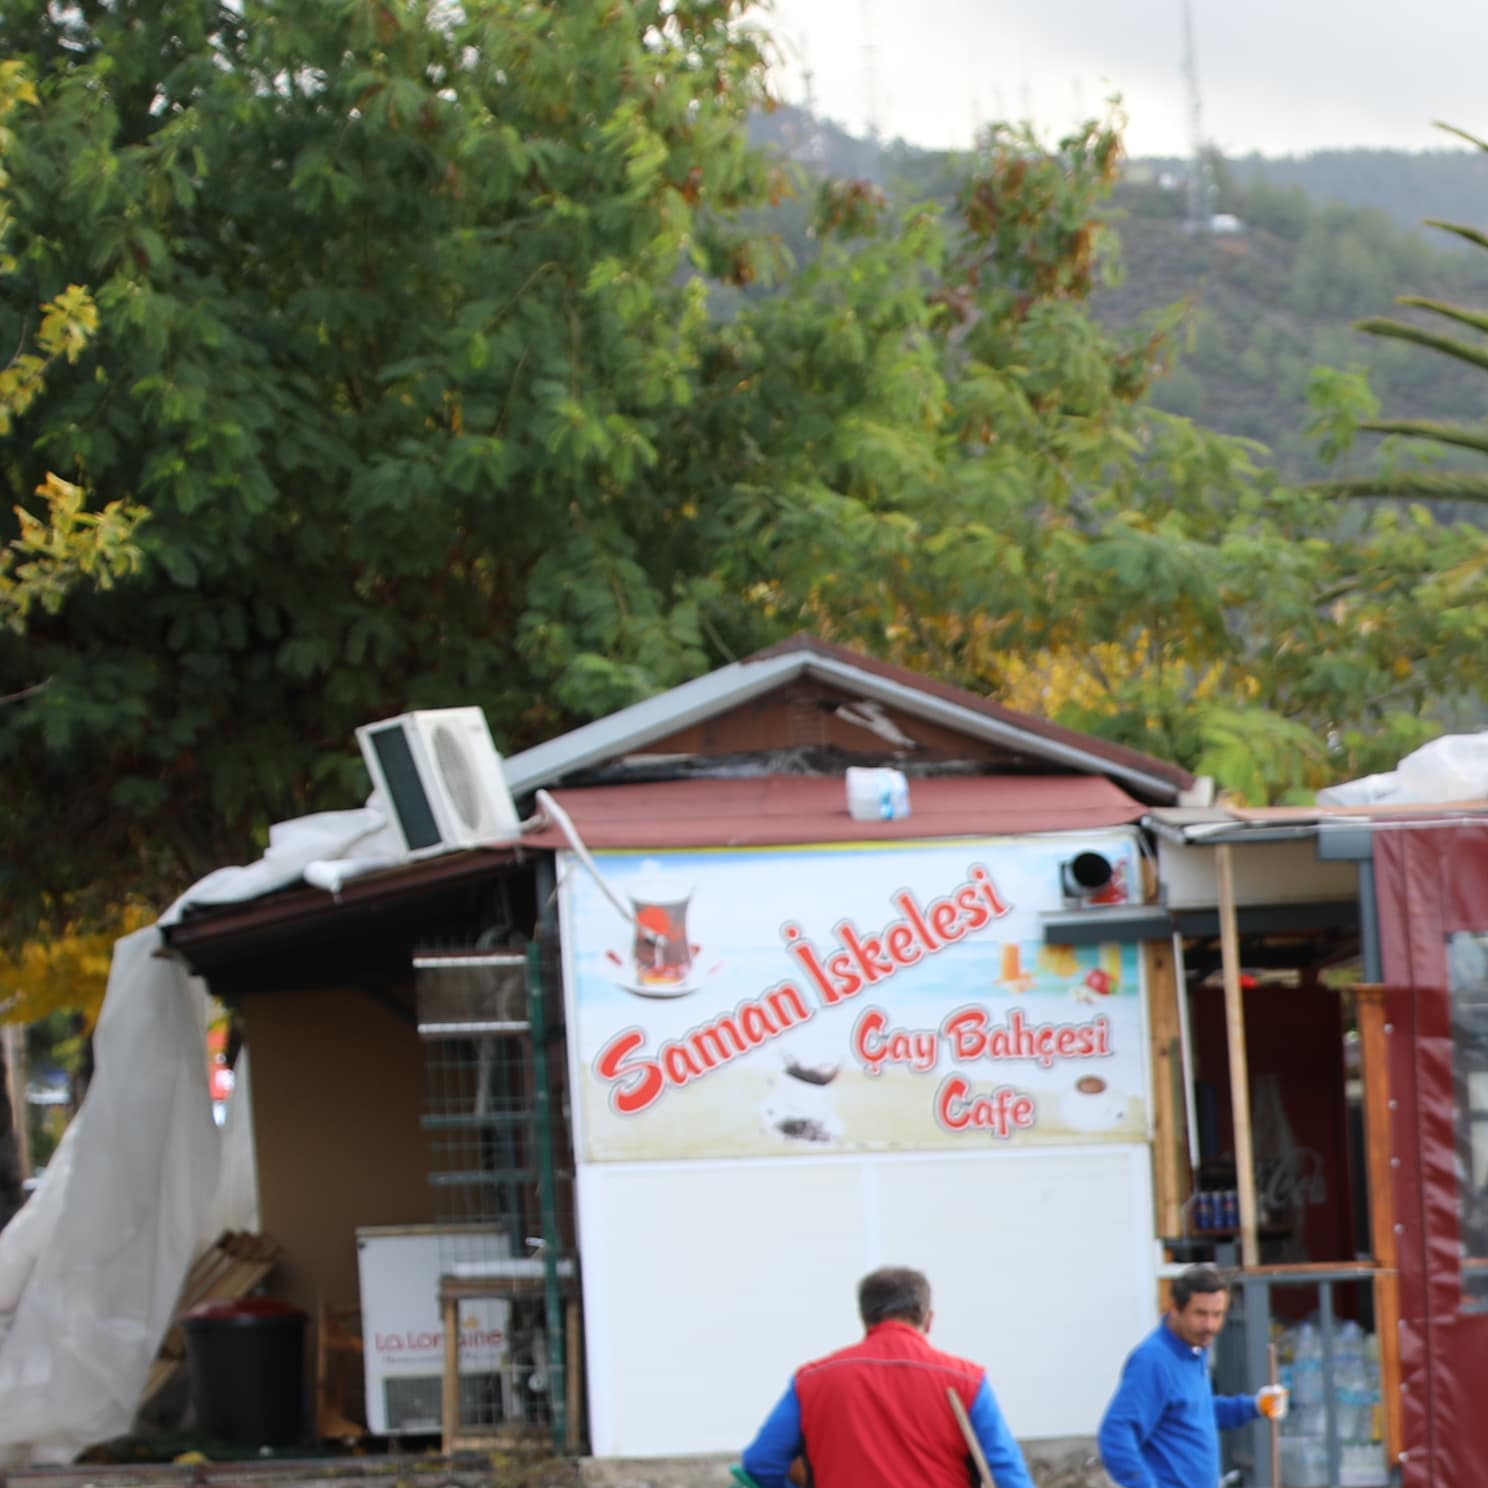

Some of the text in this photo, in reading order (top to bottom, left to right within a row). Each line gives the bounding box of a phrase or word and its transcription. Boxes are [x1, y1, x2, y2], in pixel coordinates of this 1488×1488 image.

[598, 867, 1006, 1112] Saman İskelesi
[856, 1008, 1109, 1073] Çay Bahçesi
[939, 1077, 1034, 1137] Cafe
